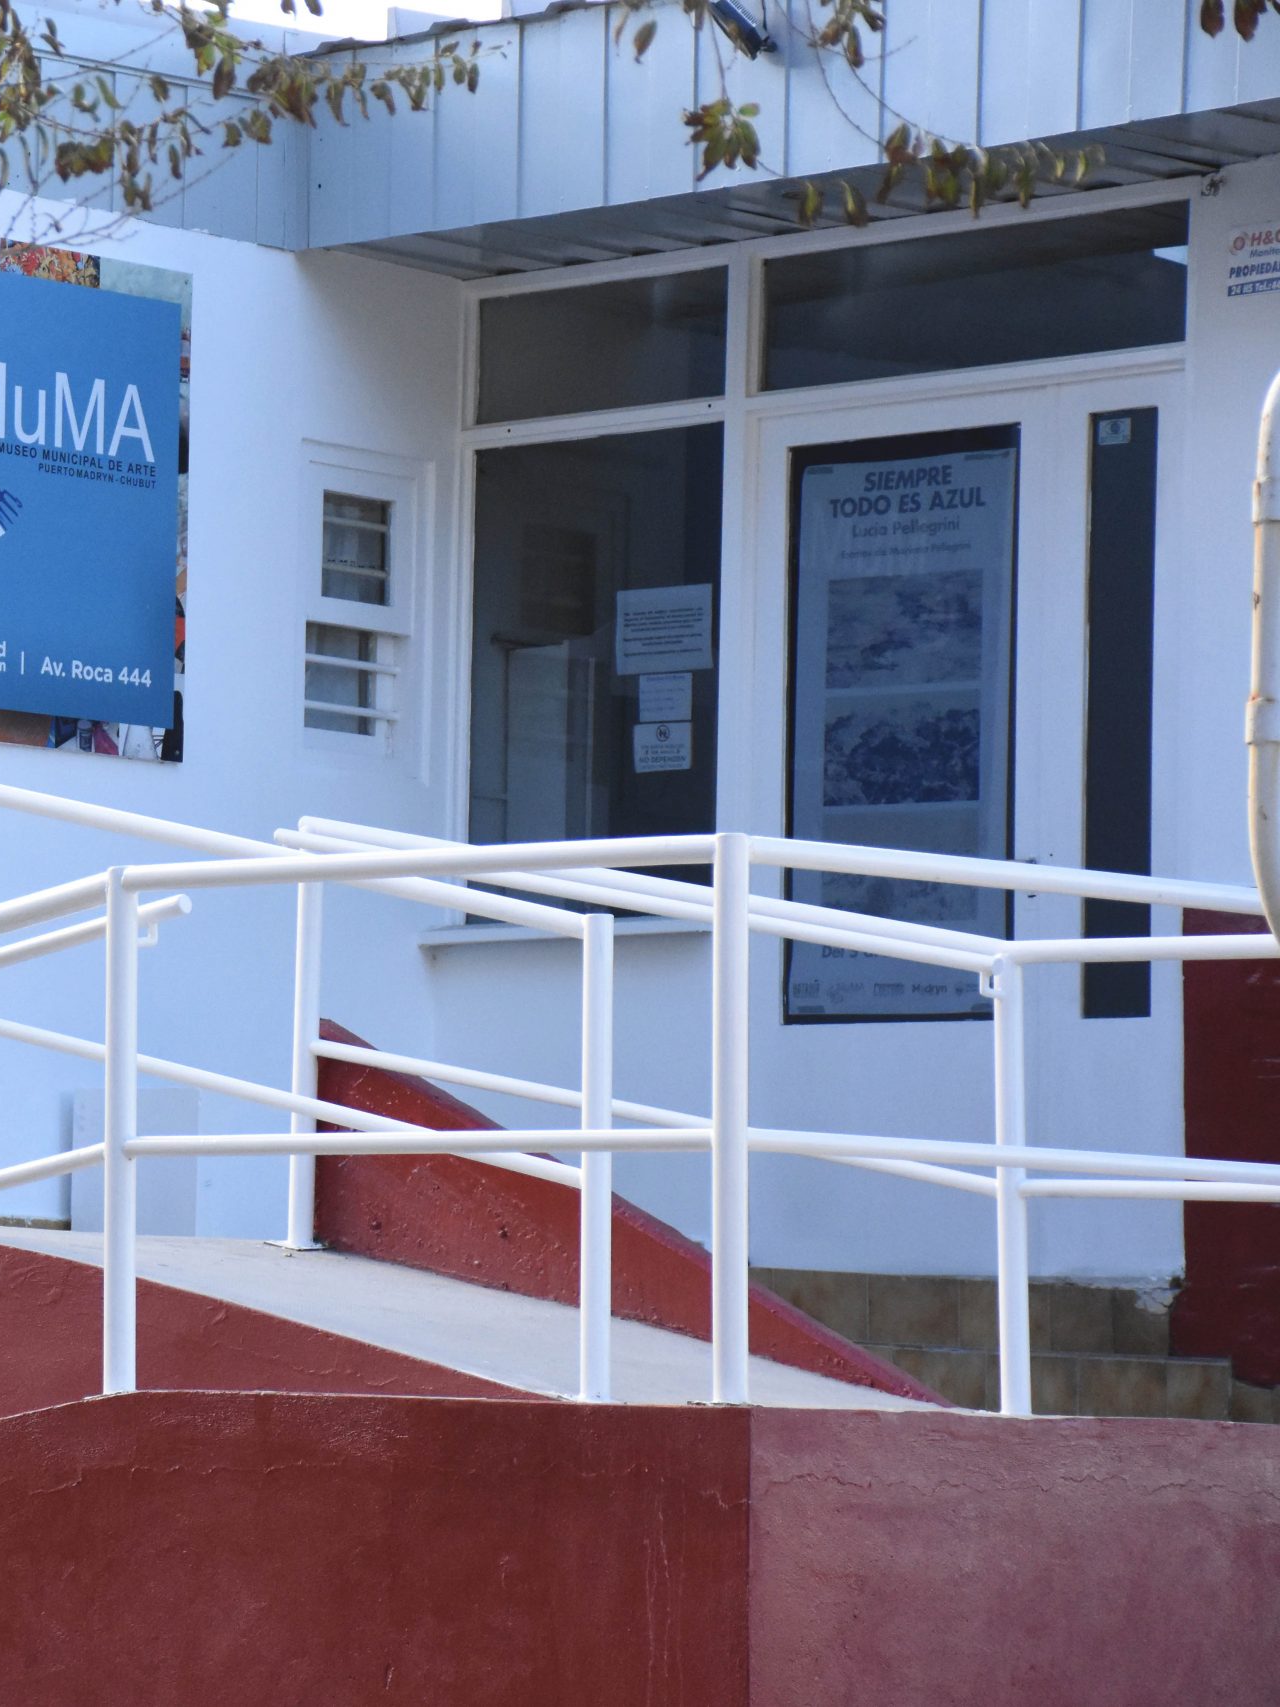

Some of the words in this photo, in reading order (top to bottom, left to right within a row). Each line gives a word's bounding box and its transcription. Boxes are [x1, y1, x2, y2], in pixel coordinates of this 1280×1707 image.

[1229, 260, 1280, 279] PROPIEDA
[38, 462, 74, 477] PUERTO
[42, 448, 104, 469] MUNICIPAL
[108, 459, 123, 472] DE
[127, 463, 157, 478] ARTE
[863, 464, 953, 492] SIEMPRE
[829, 494, 892, 519] TODO
[898, 492, 922, 514] ES
[928, 486, 987, 511] AZUL
[892, 514, 961, 537] Pellegrini
[40, 655, 66, 678] Av.
[71, 659, 113, 683] Roca
[118, 665, 152, 688] 444
